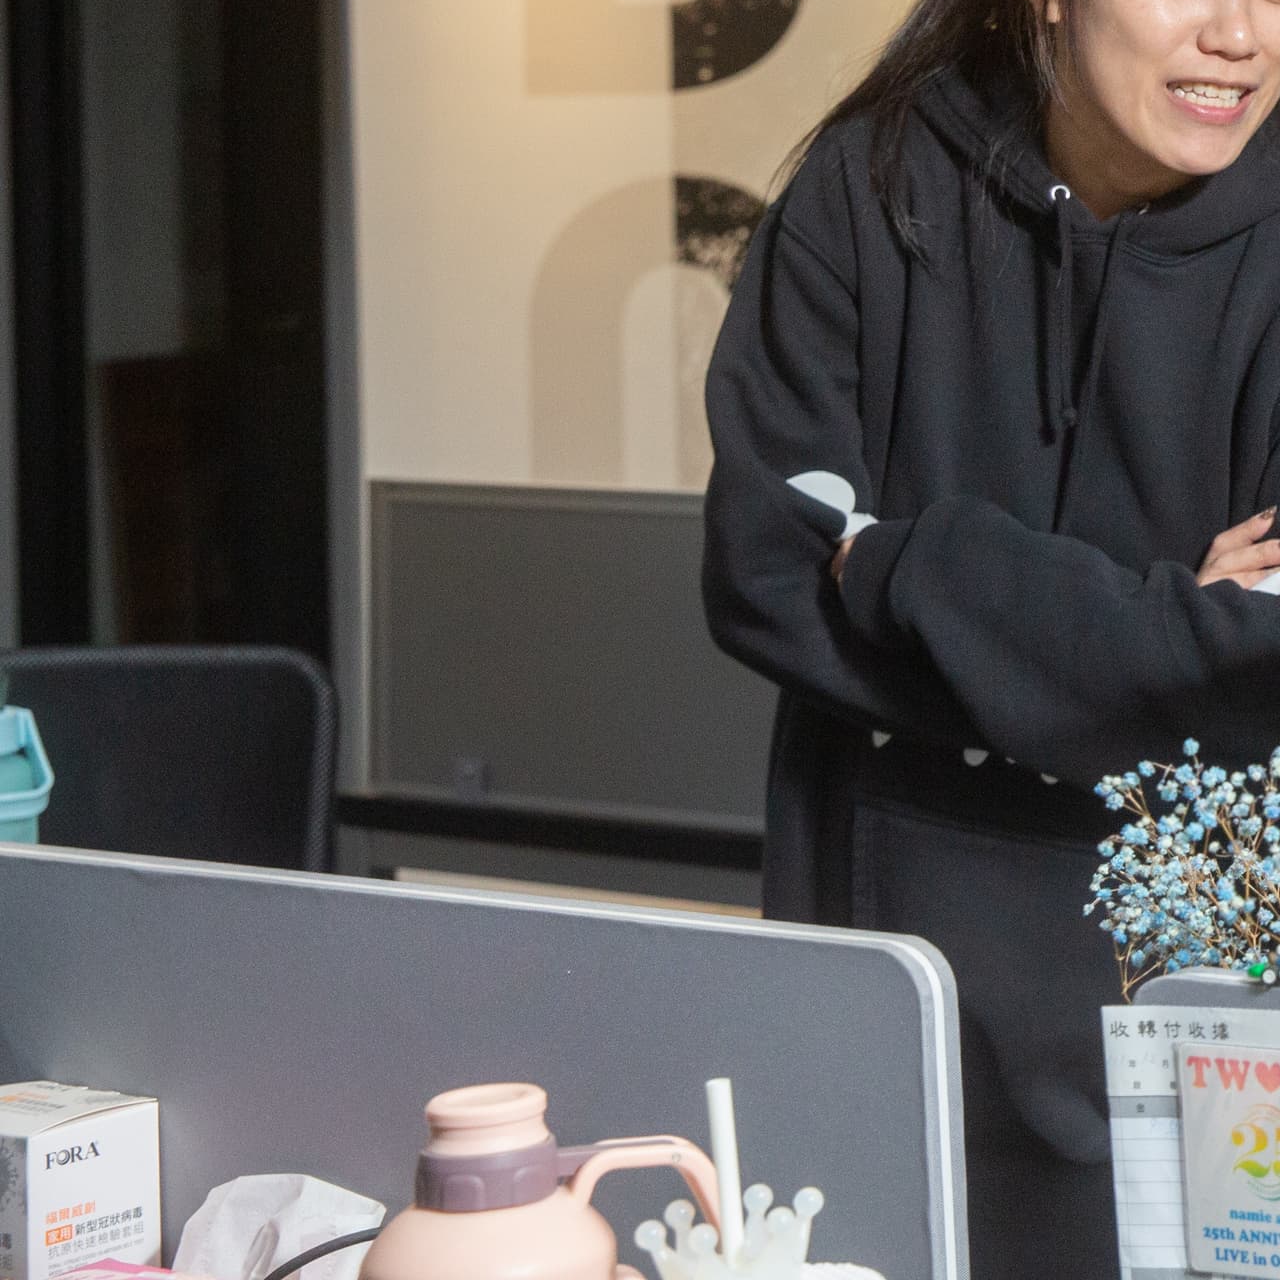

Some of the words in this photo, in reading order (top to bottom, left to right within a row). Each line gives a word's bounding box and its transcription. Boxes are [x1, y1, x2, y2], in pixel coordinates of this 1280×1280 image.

[45, 1141, 100, 1170] FORA
[1229, 1208, 1272, 1223] namie
[1202, 1225, 1236, 1241] 25th
[1215, 1247, 1249, 1264] LIVE
[1253, 1251, 1267, 1266] in
